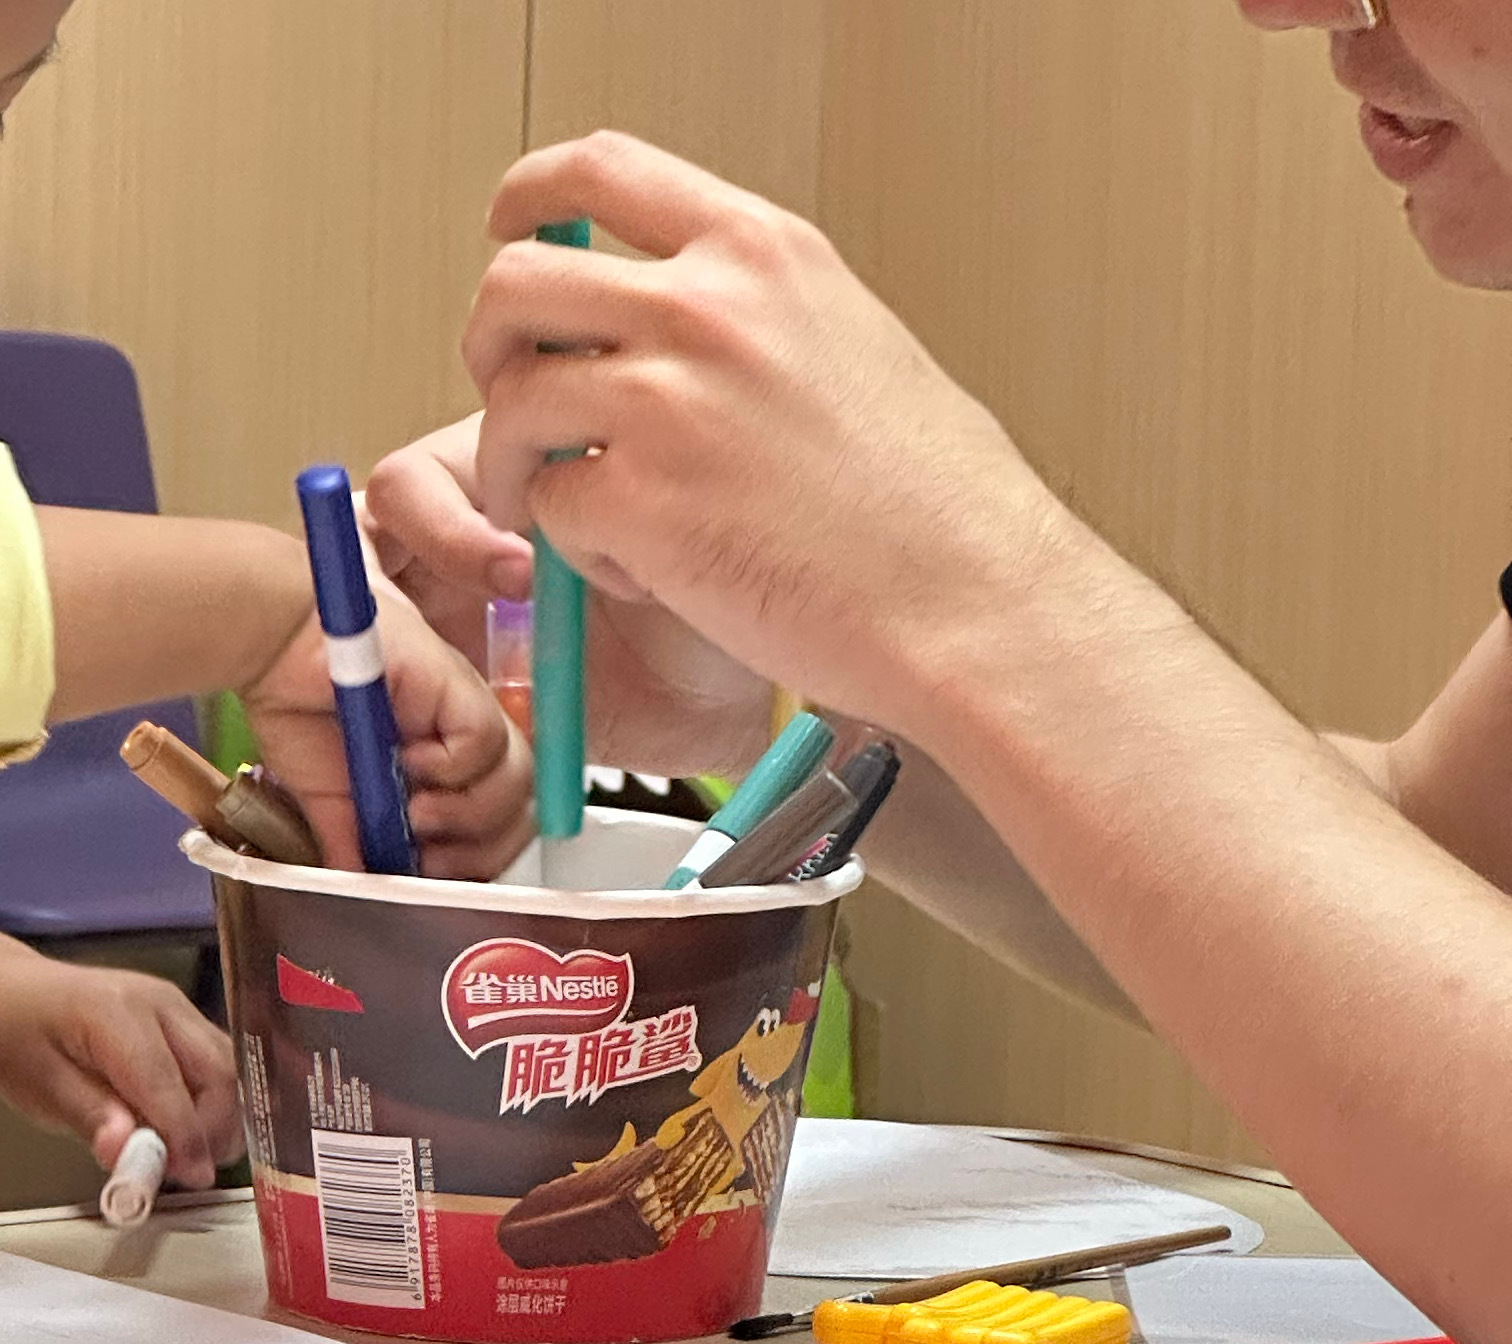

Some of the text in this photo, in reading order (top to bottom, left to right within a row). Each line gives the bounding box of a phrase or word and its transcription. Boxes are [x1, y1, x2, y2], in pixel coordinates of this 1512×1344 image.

[459, 972, 537, 1004] 雀巢
[506, 1010, 692, 1104] 脆脆鲨
[495, 1293, 567, 1314] 涂层威化饼干
